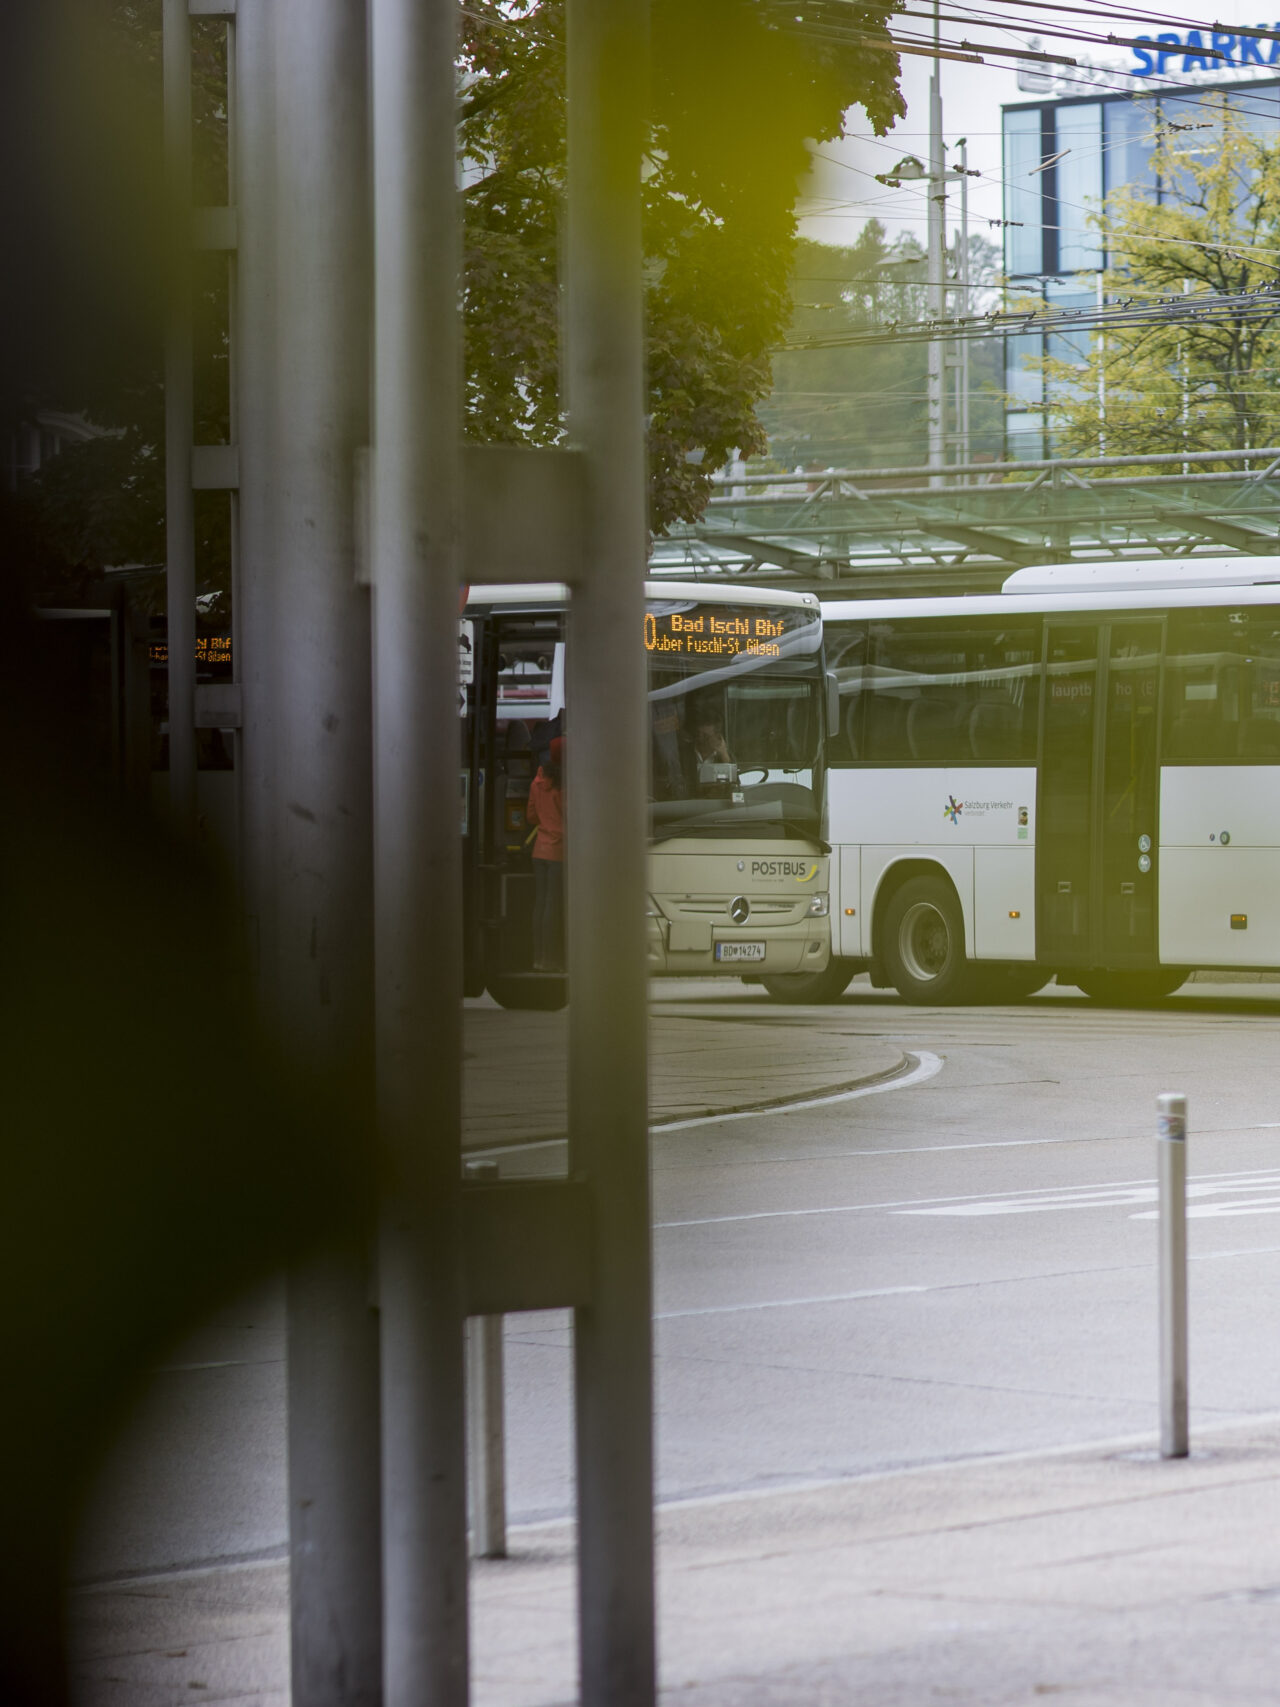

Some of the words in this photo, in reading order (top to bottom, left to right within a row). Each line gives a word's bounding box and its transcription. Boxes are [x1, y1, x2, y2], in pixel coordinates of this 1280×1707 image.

[671, 614, 704, 632] Bad
[710, 616, 749, 635] Ischl
[755, 619, 785, 636] Bhf
[656, 634, 683, 651] über
[746, 638, 780, 656] Gilgen
[964, 801, 990, 810] Salzburg
[990, 801, 1013, 809] Verkehr
[751, 861, 806, 876] POSTBUS
